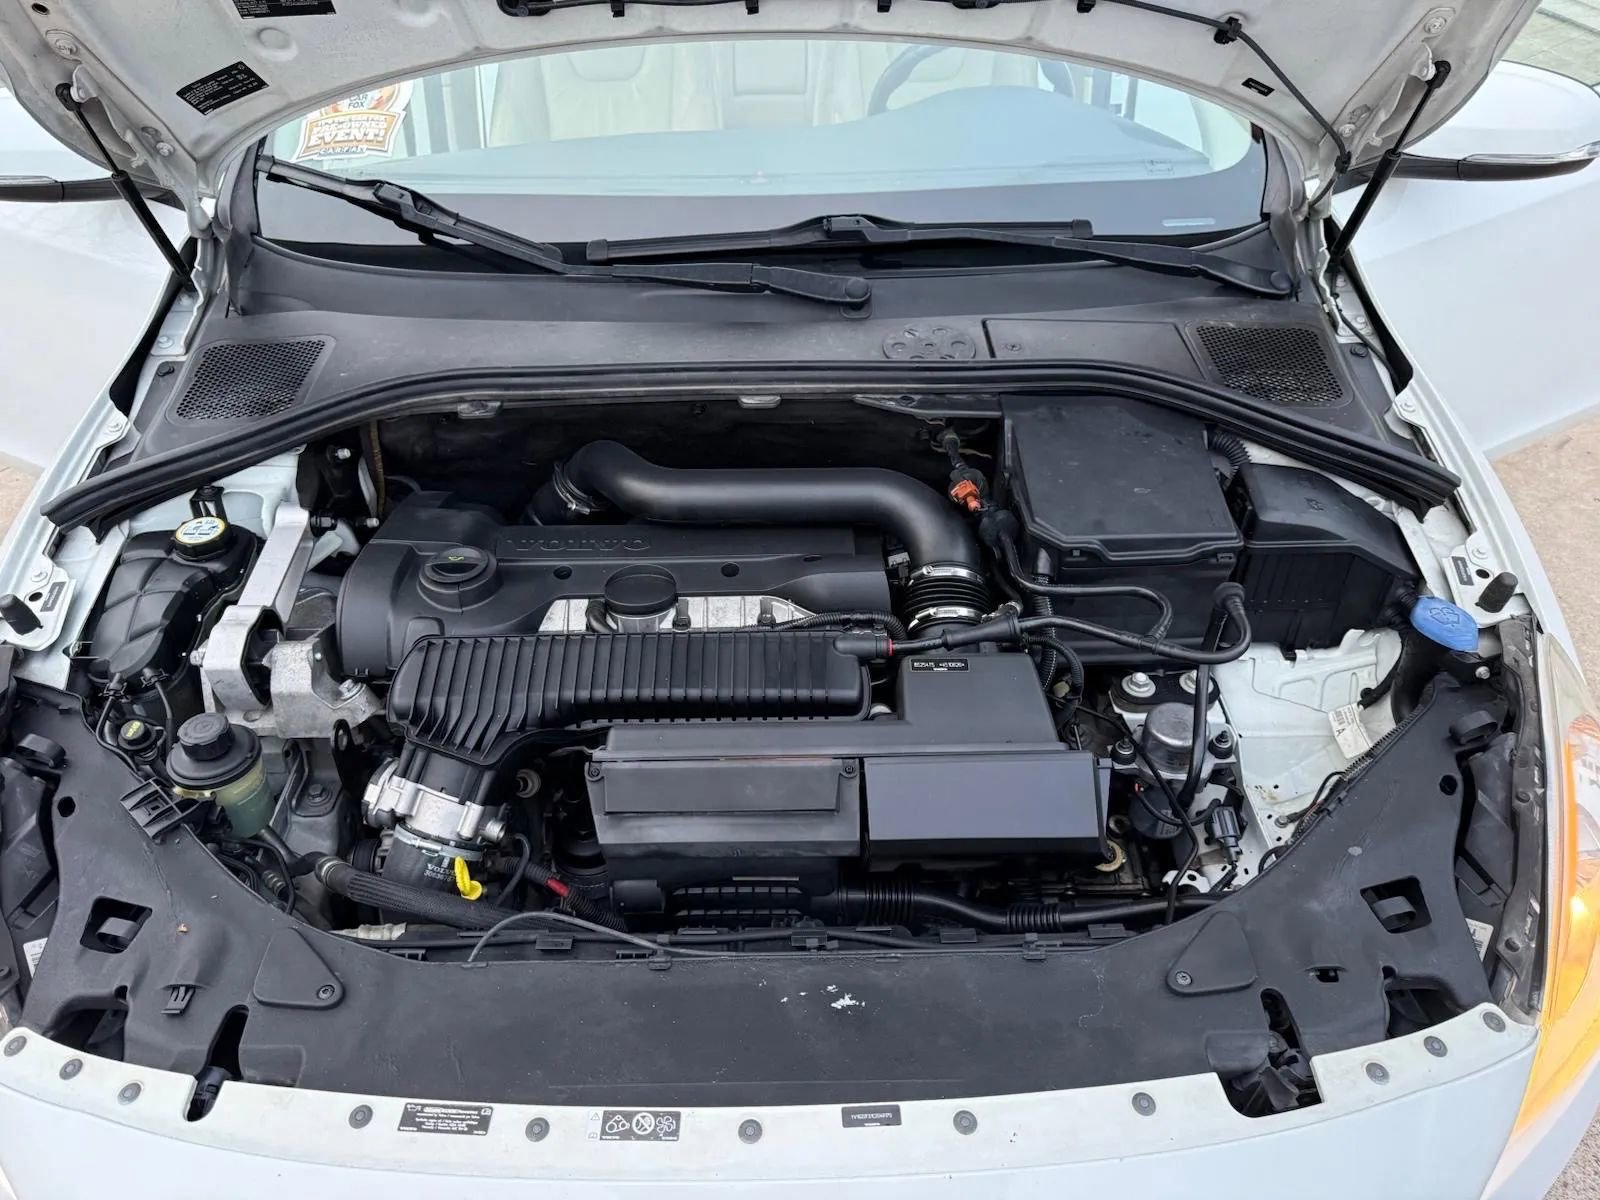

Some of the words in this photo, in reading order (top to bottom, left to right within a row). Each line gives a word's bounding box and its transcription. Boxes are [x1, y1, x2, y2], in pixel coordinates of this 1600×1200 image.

[347, 101, 365, 109] FOX
[308, 128, 384, 147] EVENT!
[504, 539, 650, 551] VOLVO
